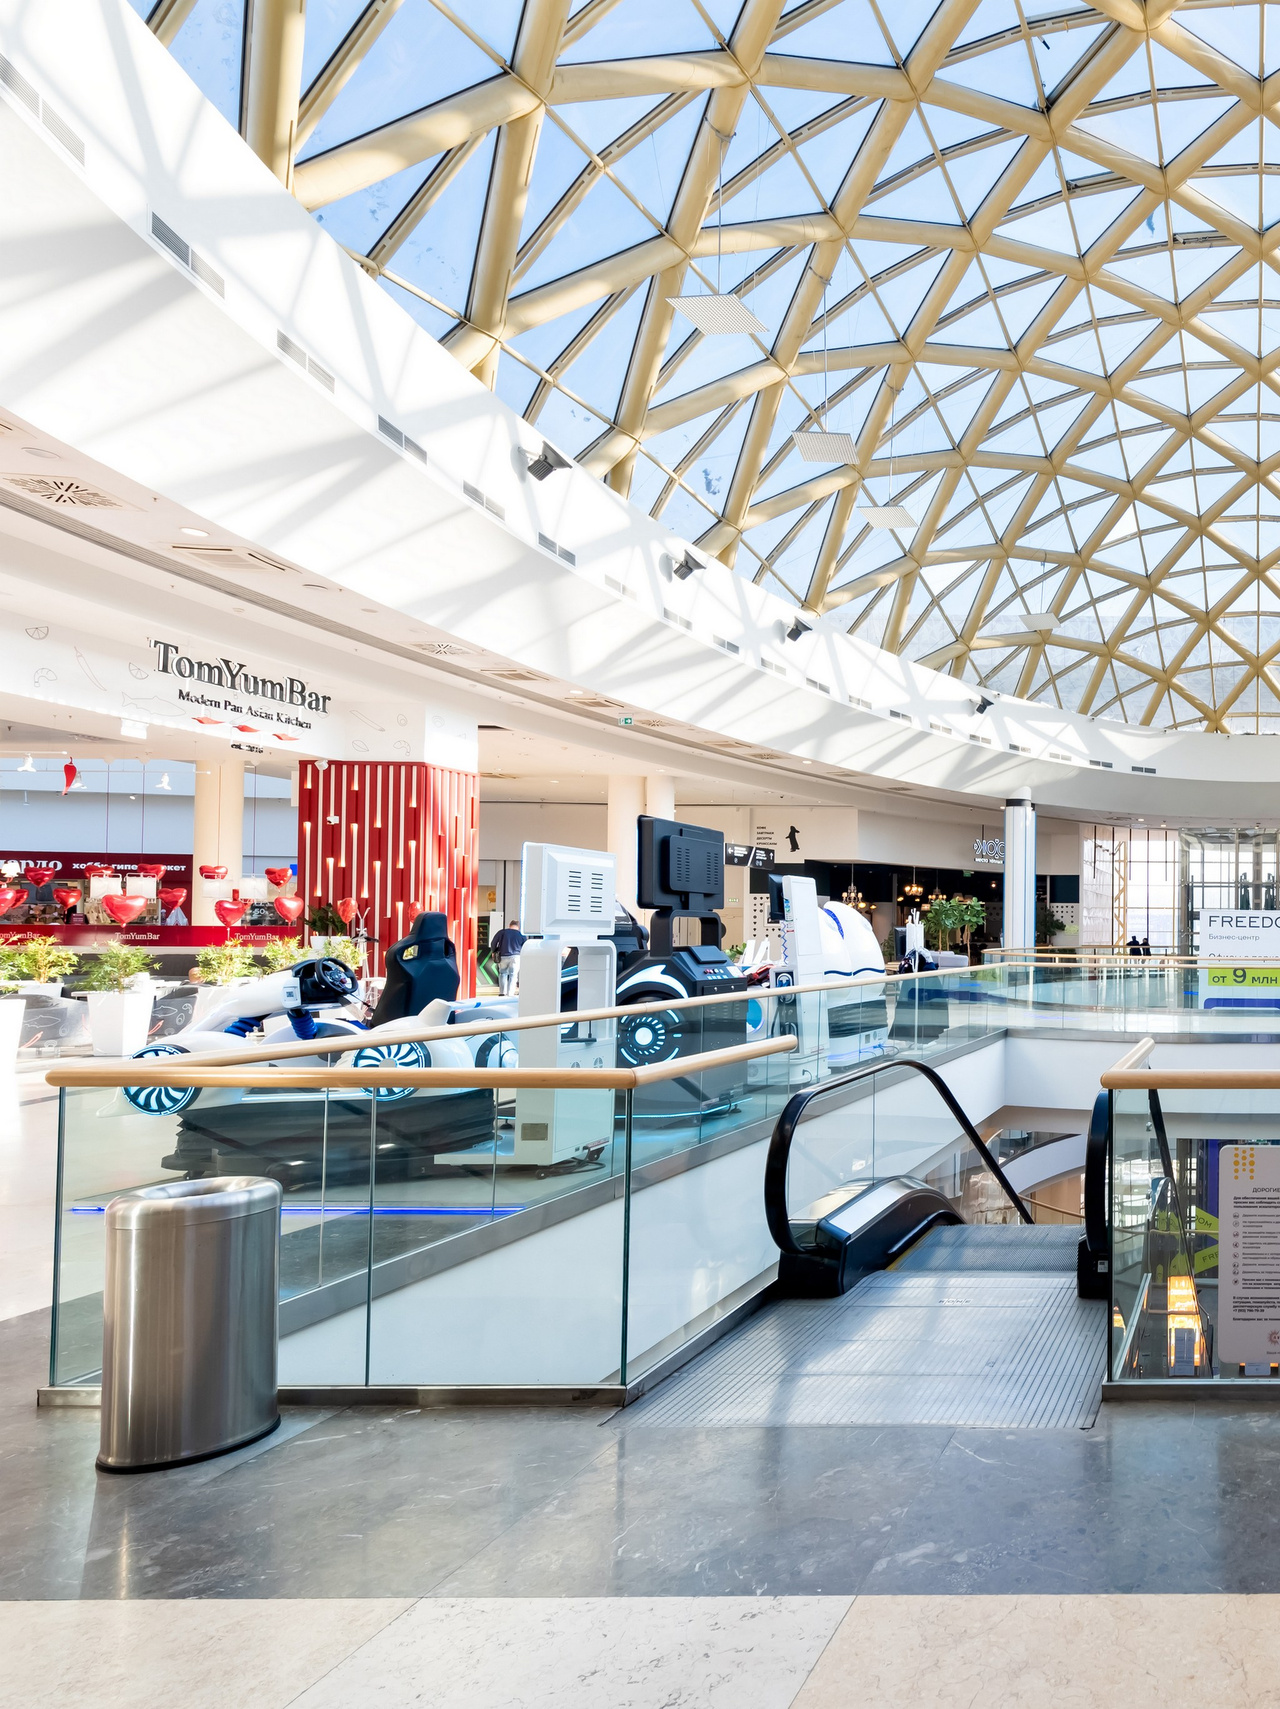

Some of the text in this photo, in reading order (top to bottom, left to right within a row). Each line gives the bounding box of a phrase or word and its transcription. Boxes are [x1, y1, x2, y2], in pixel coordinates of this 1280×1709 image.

[150, 639, 331, 714] TomYumBar
[178, 689, 312, 729] Modern Pan Asian Kitchen
[115, 932, 160, 941] TomYumBar
[1208, 933, 1260, 941] Бизнес-центр
[1212, 975, 1227, 983] от
[1232, 968, 1247, 984] 9
[1251, 976, 1278, 984] млн
